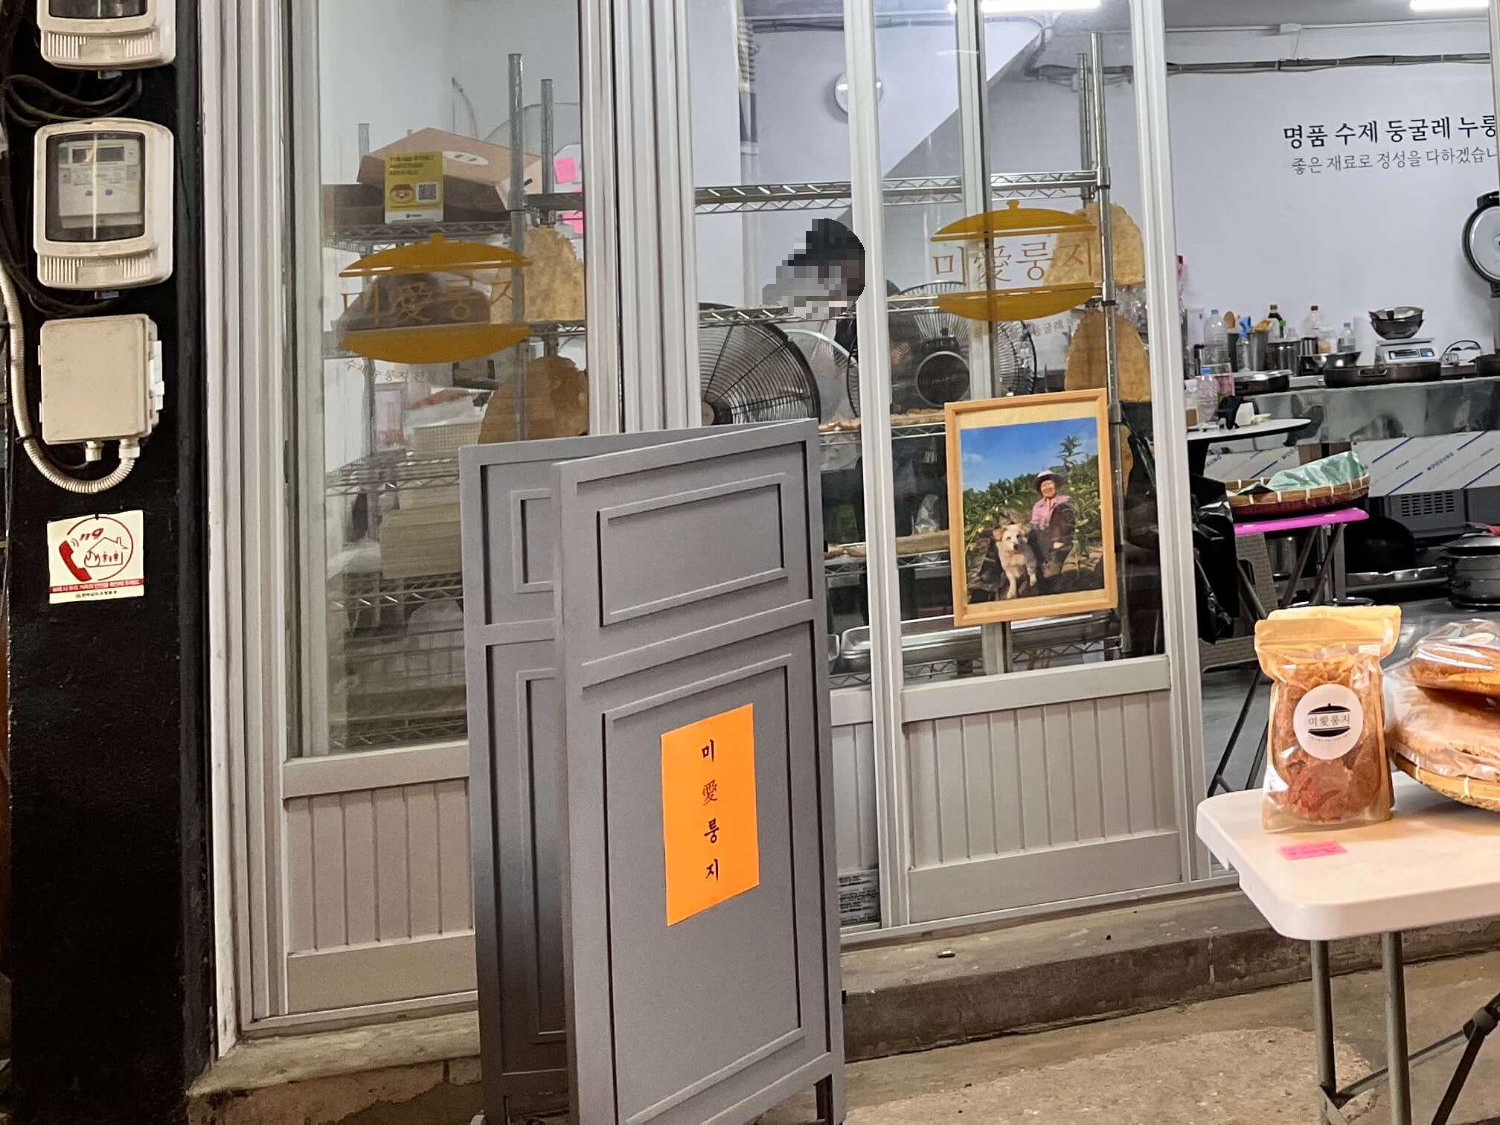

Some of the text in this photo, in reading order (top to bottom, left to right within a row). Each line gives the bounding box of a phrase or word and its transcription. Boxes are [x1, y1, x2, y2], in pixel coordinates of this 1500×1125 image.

[1283, 124, 1328, 150] 명품
[1334, 120, 1379, 145] 수제
[1385, 116, 1451, 143] 둥굴레
[1292, 156, 1323, 176] 좋은
[1326, 154, 1374, 172] 재료로
[1377, 150, 1422, 170] 정성을
[80, 527, 104, 542] 119
